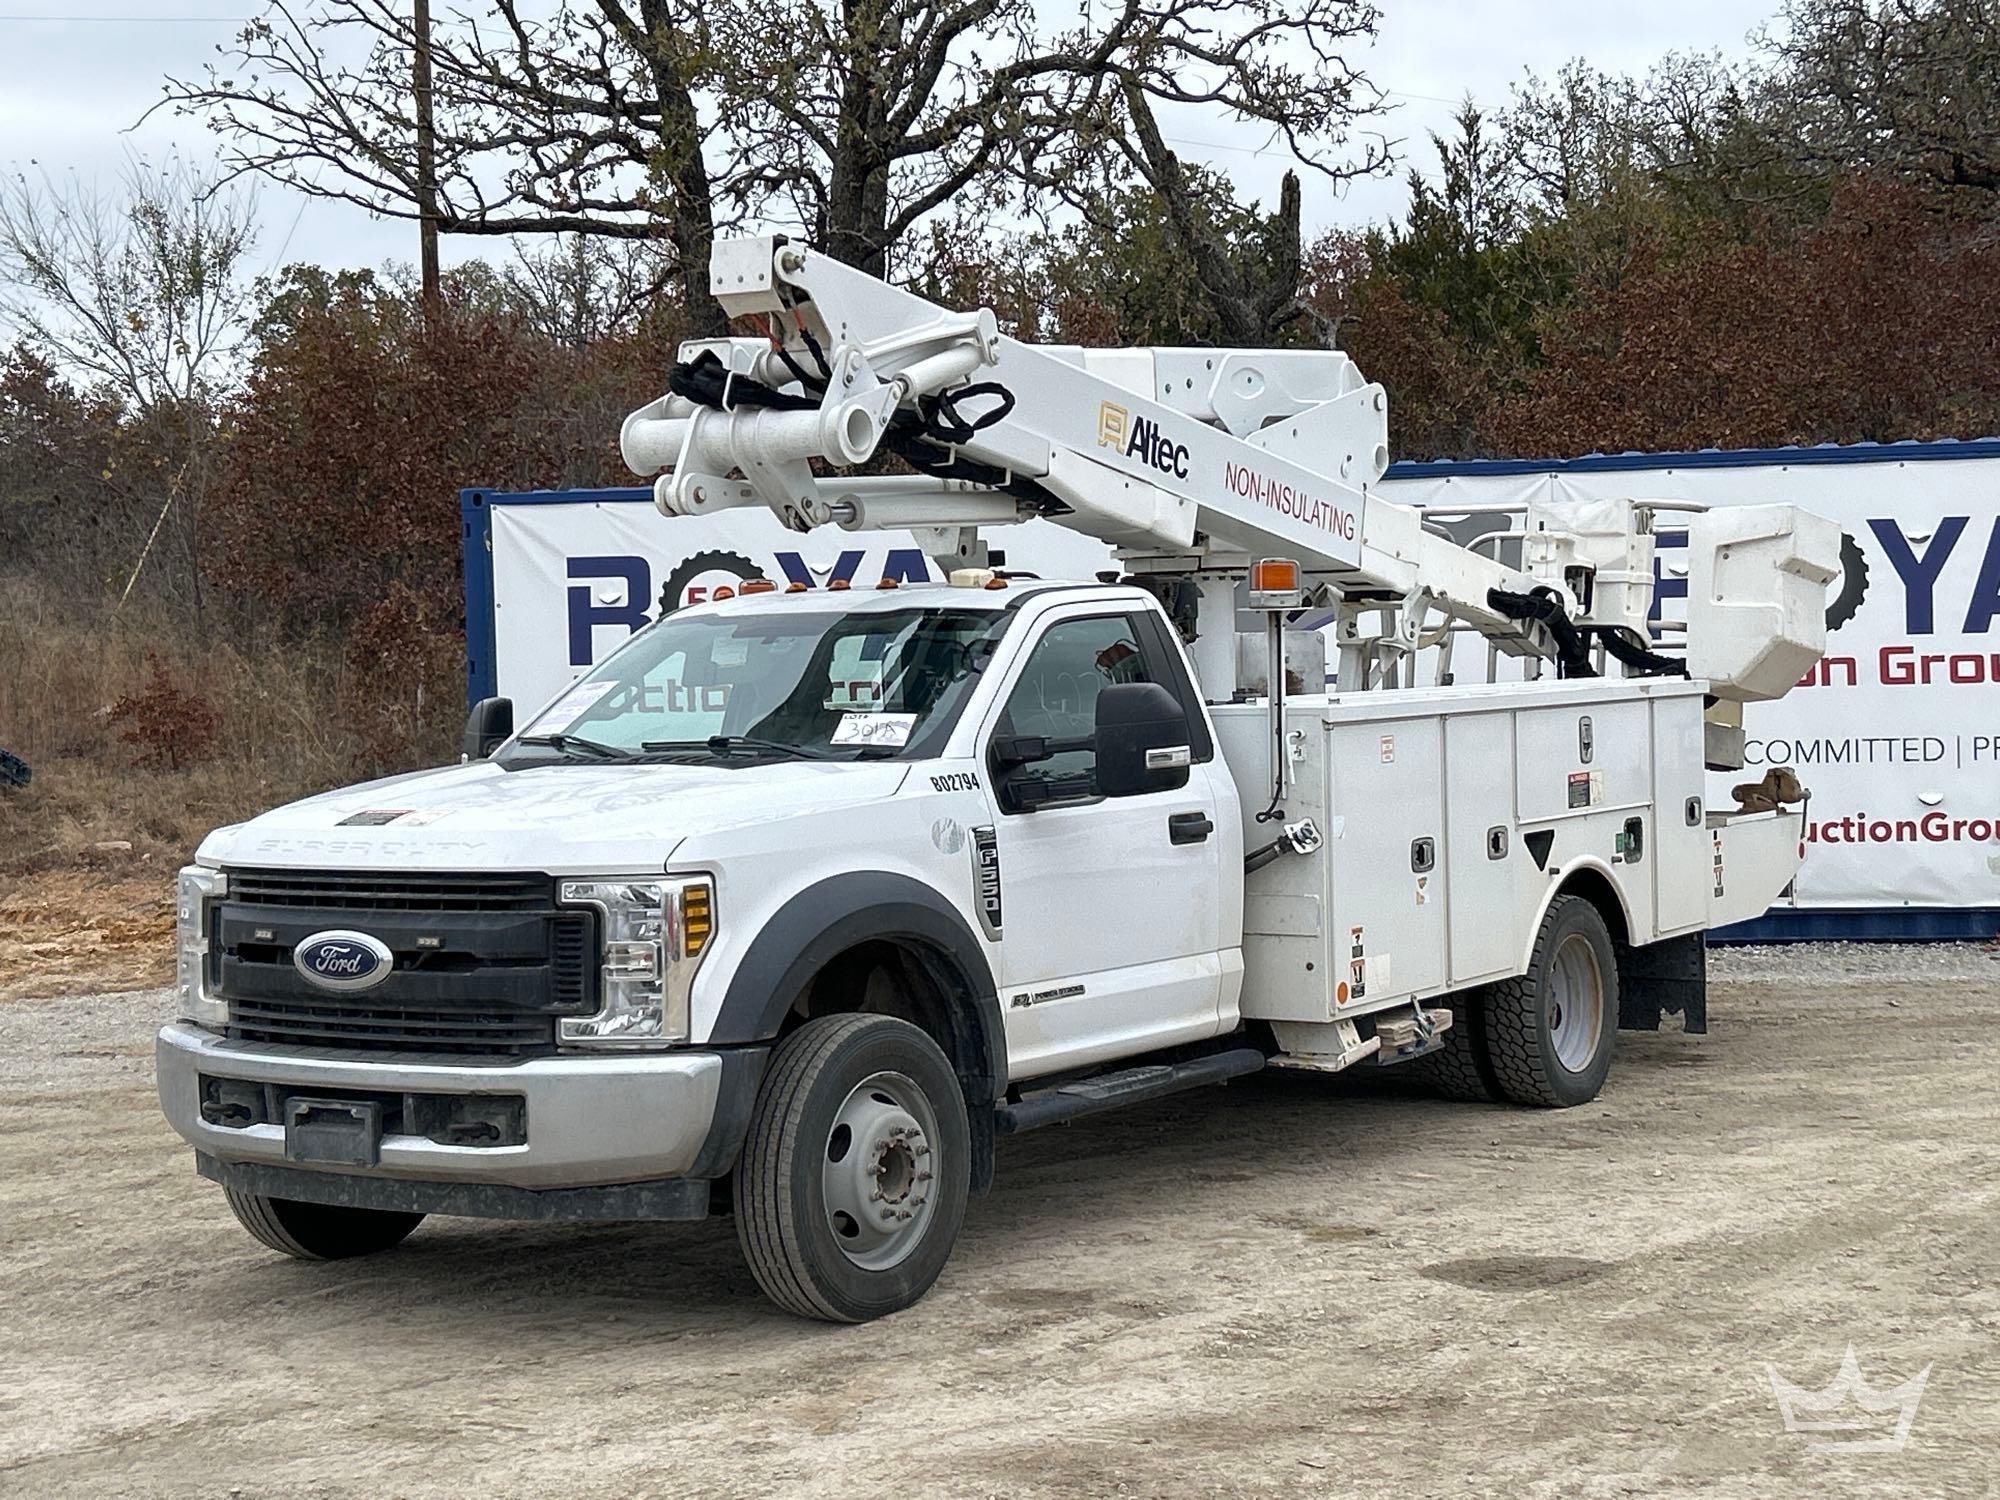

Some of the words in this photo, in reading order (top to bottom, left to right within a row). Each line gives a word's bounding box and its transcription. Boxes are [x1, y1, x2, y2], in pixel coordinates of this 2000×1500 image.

[1126, 415, 1190, 479] Altec
[1224, 461, 1355, 541] NON-INSULATING
[1879, 646, 2000, 685] Gro
[1743, 737, 1945, 765] COMMITTED
[1807, 811, 2000, 844] uctionGro
[316, 945, 361, 976] Ford
